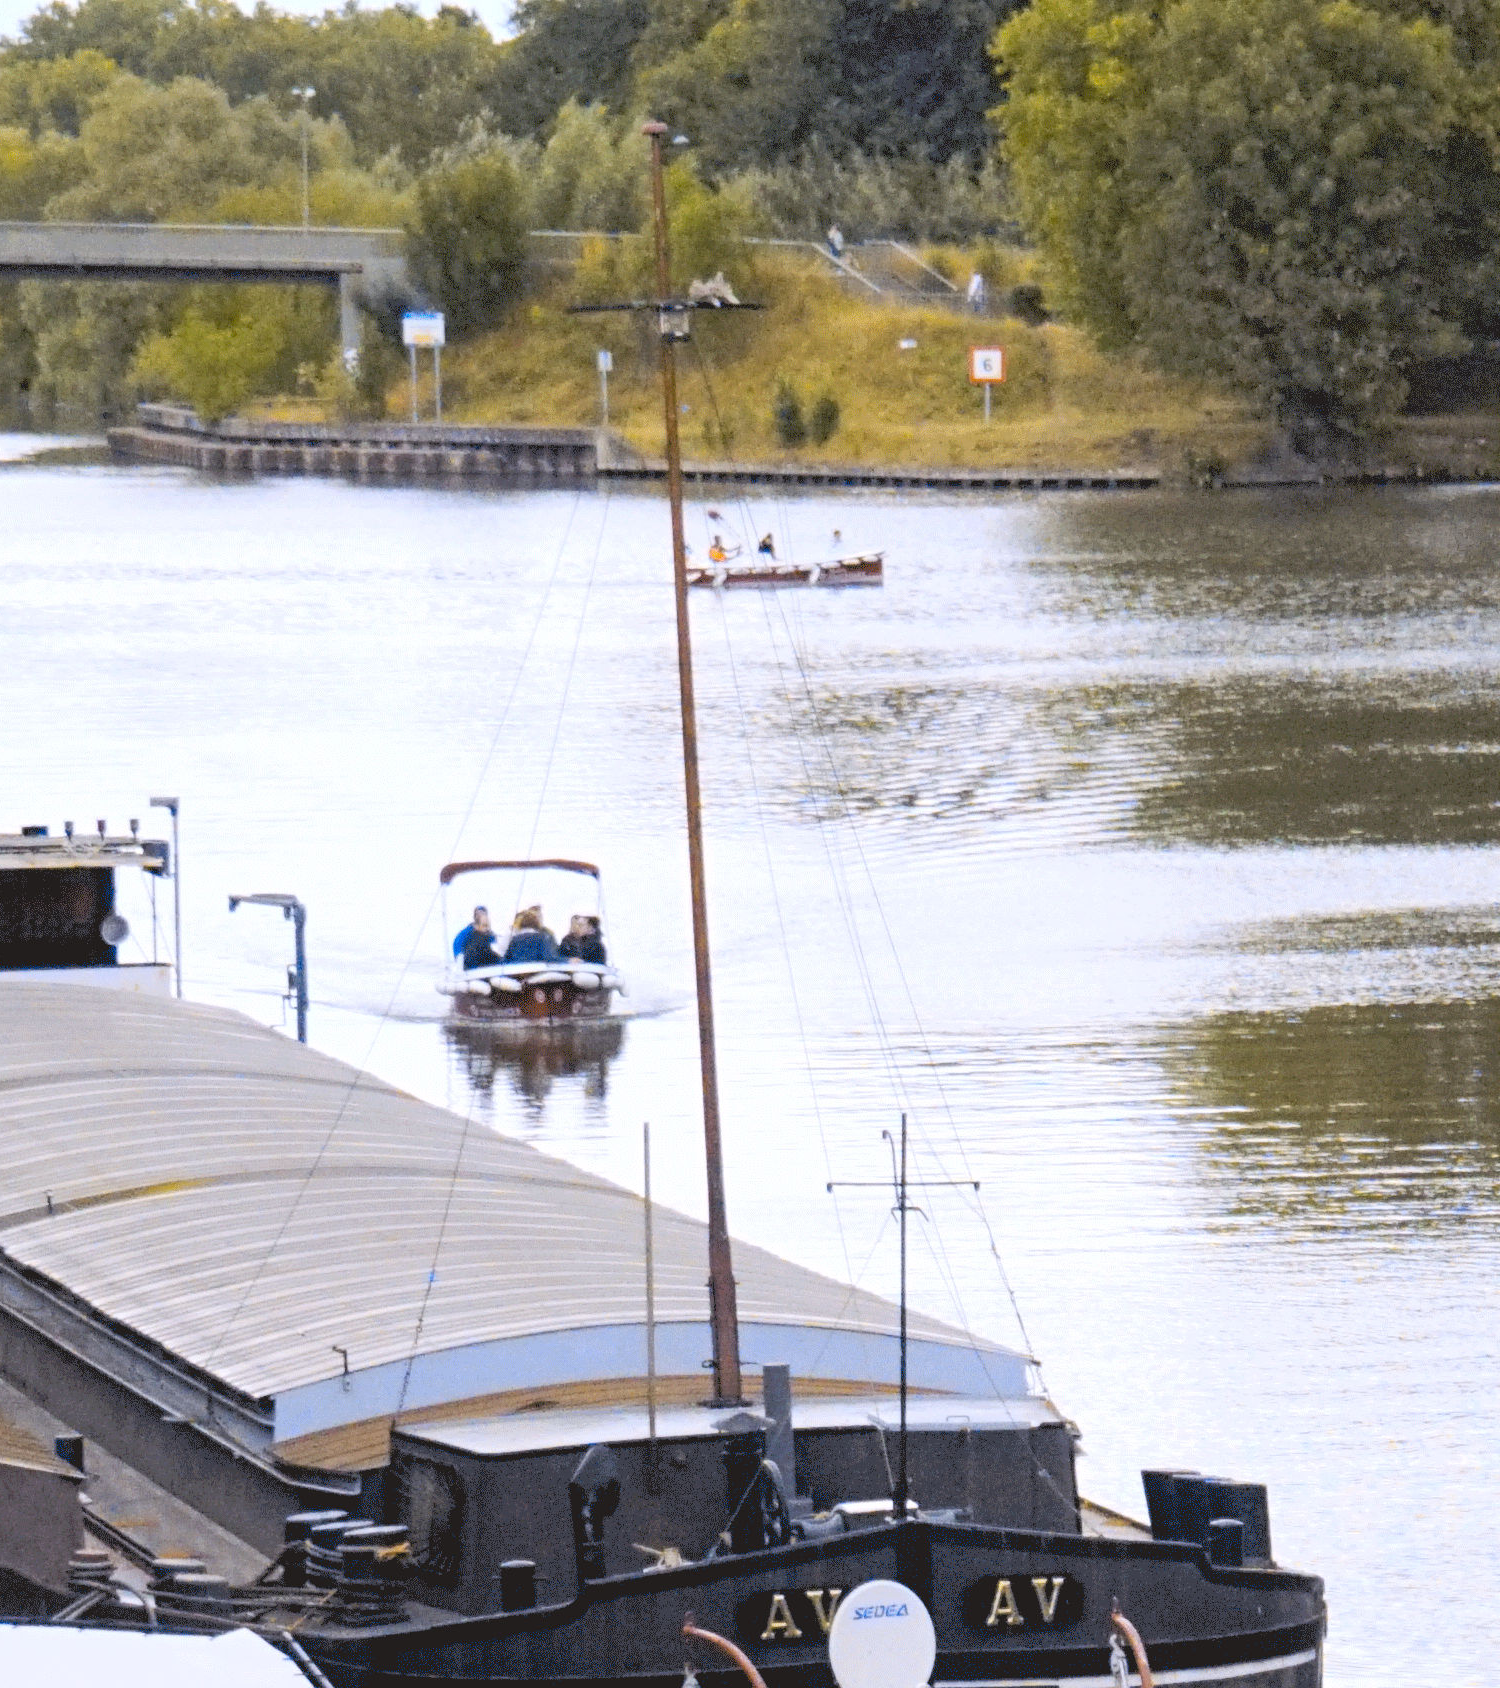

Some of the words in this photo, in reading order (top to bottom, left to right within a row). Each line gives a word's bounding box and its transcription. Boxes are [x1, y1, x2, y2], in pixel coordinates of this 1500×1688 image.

[982, 357, 993, 372] 6
[985, 1576, 1065, 1626] AV
[852, 1603, 909, 1621] SEDEA
